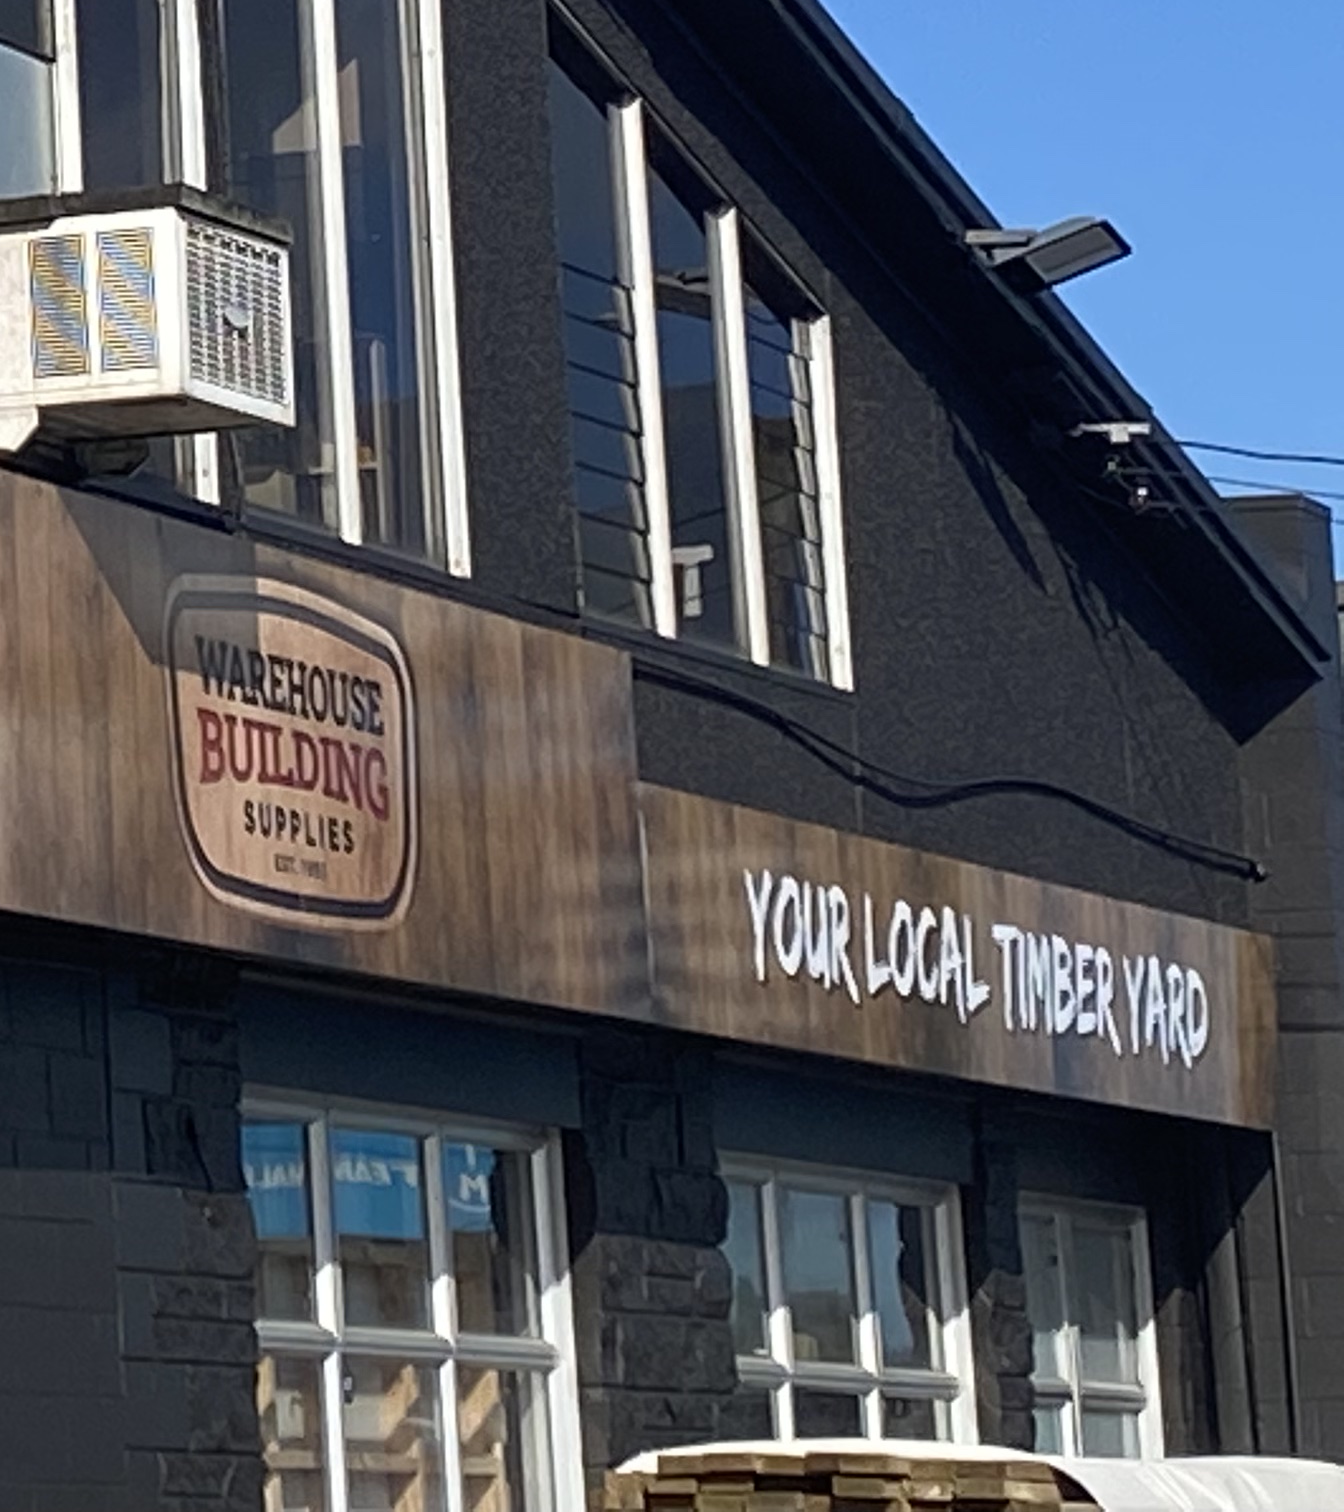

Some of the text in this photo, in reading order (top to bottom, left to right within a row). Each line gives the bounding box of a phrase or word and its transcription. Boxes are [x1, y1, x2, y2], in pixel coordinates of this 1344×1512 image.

[194, 635, 385, 736] WAREHOUSE
[196, 707, 390, 822] BUILDING
[244, 799, 355, 854] SUPPLIES
[743, 868, 1210, 1069] YOUR LOCAL TIMBER YARD
